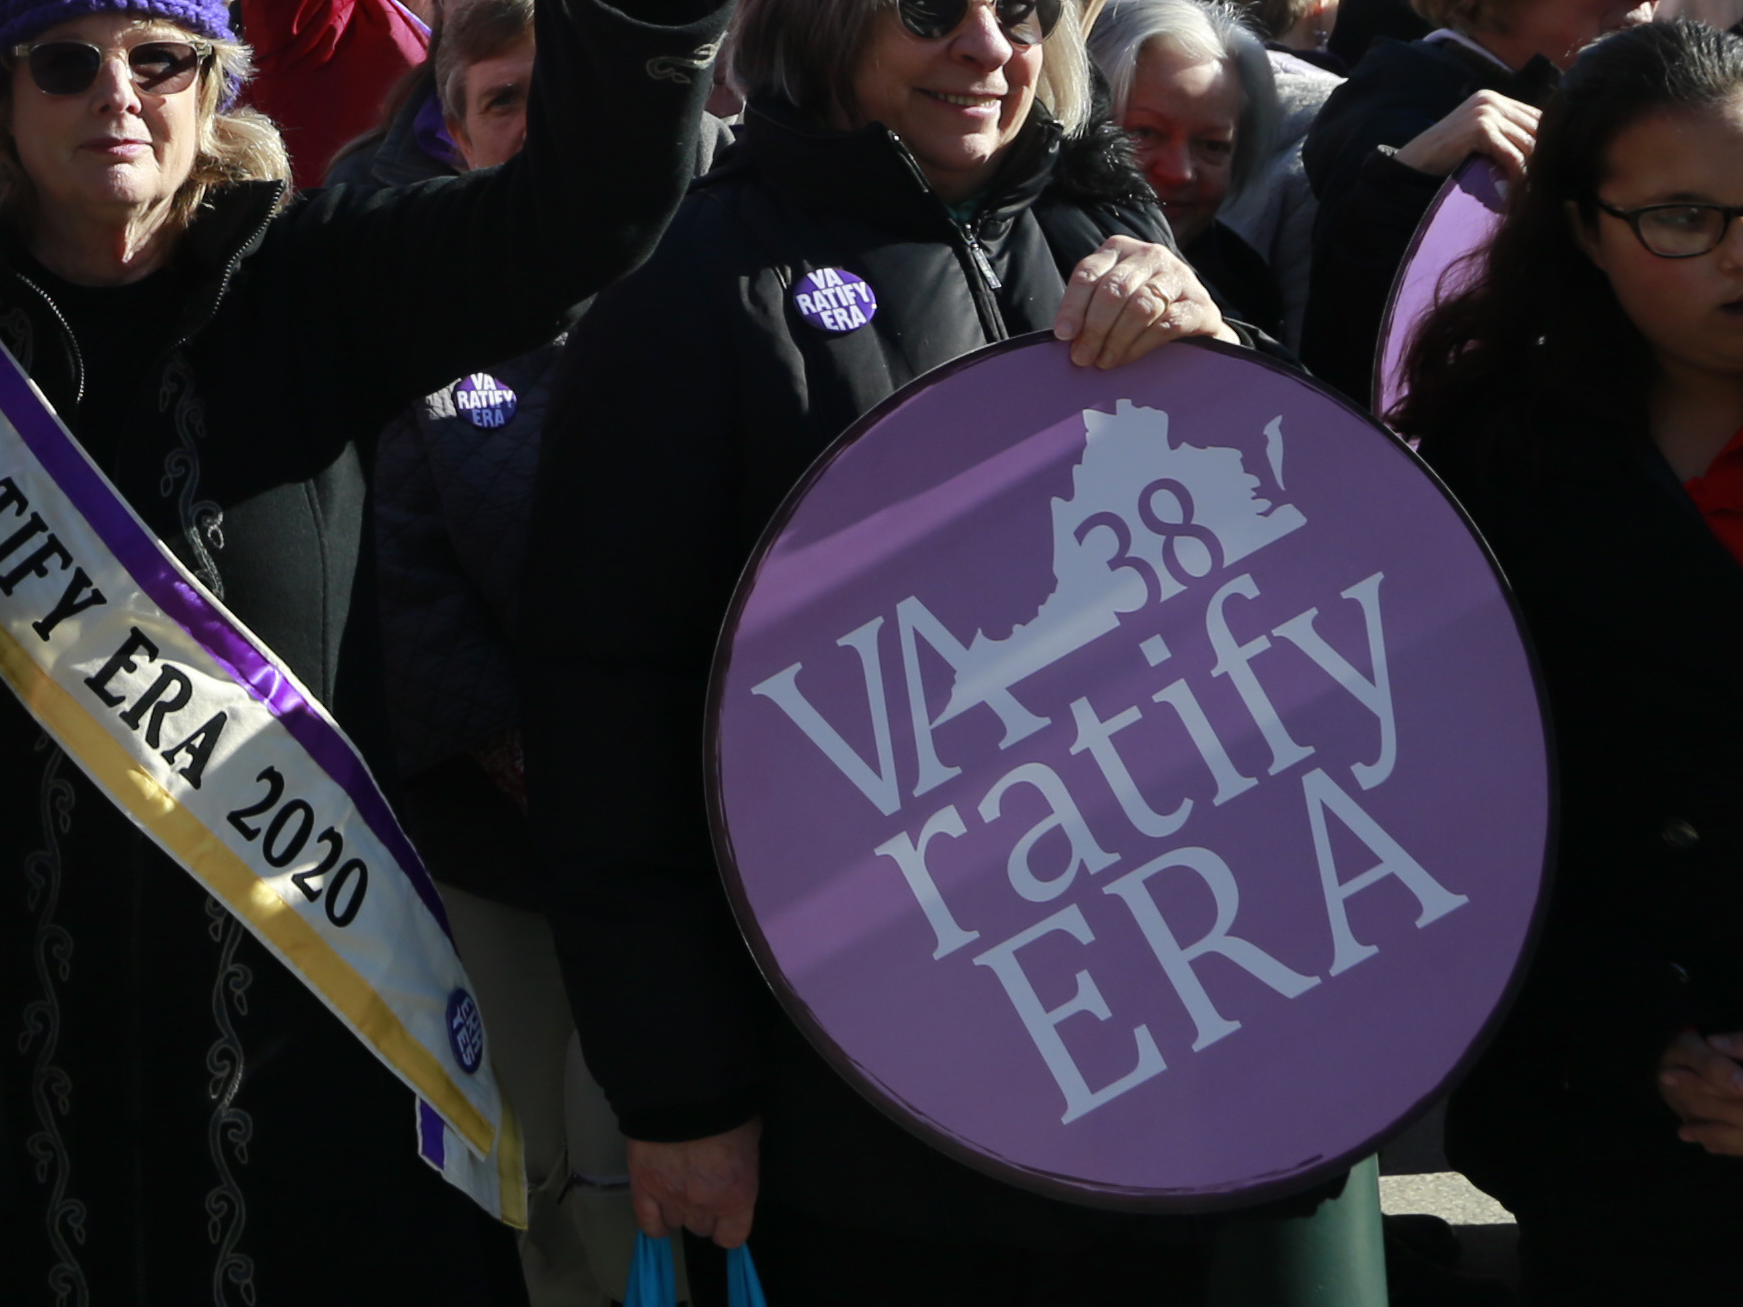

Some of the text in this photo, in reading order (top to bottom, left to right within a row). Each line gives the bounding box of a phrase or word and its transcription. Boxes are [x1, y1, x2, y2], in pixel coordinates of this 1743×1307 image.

[807, 267, 844, 290] VA
[796, 281, 870, 315] RATIFY
[820, 305, 867, 330] ERA
[470, 372, 497, 391] VA
[456, 390, 514, 410] RATIFY
[471, 409, 505, 428] ERA
[1072, 477, 1225, 614] 38
[751, 594, 1052, 817] VA
[84, 627, 232, 791] ERA
[225, 766, 369, 928] 2020
[873, 571, 1398, 961] ratify
[973, 767, 1470, 1125] ERA
